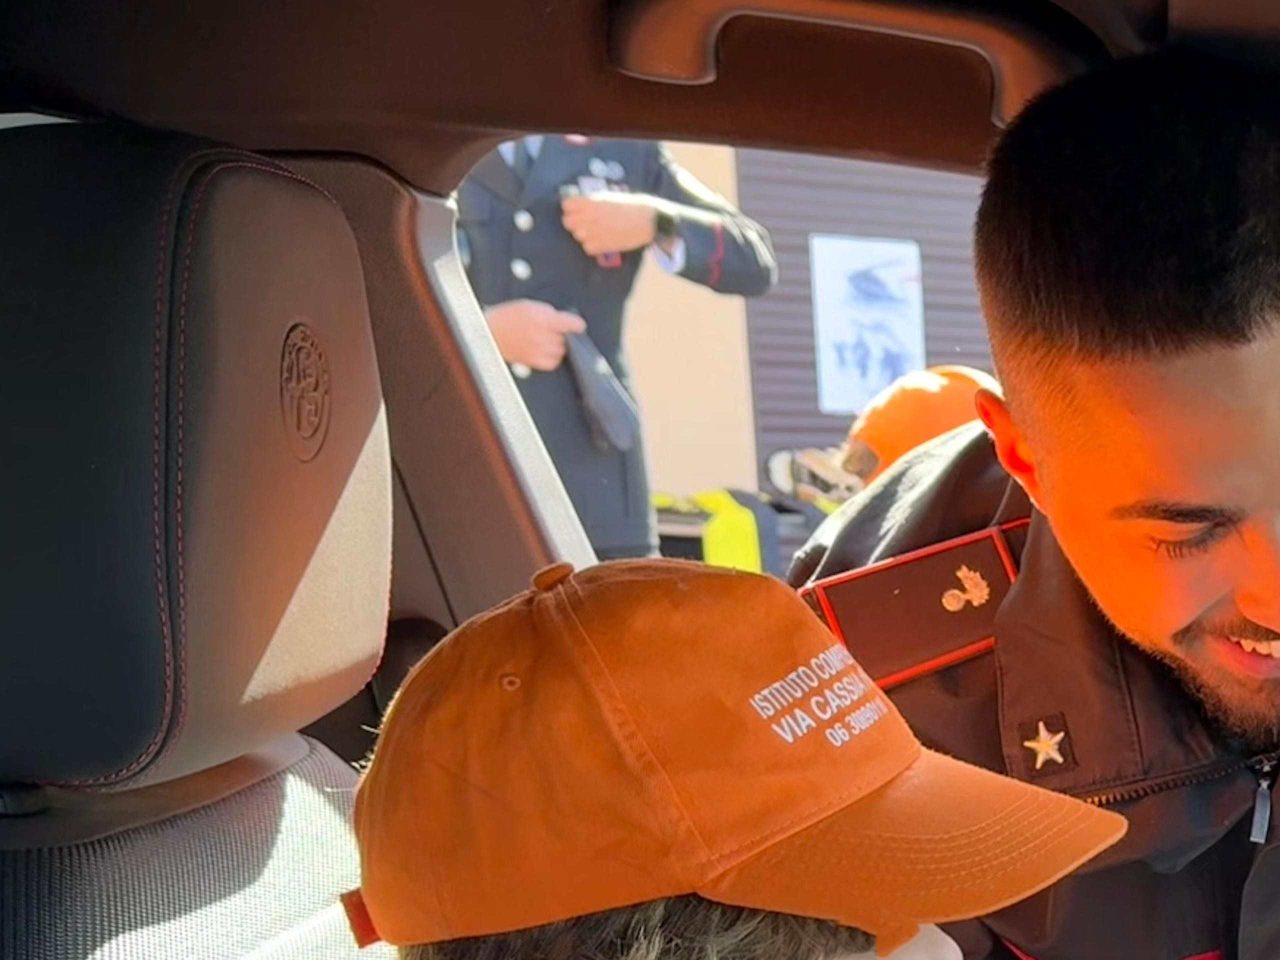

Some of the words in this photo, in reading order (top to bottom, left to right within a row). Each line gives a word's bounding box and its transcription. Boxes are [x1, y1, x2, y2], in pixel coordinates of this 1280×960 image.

[749, 665, 819, 720] ISTITUTO
[771, 708, 817, 743] VIA
[825, 722, 850, 747] 06
